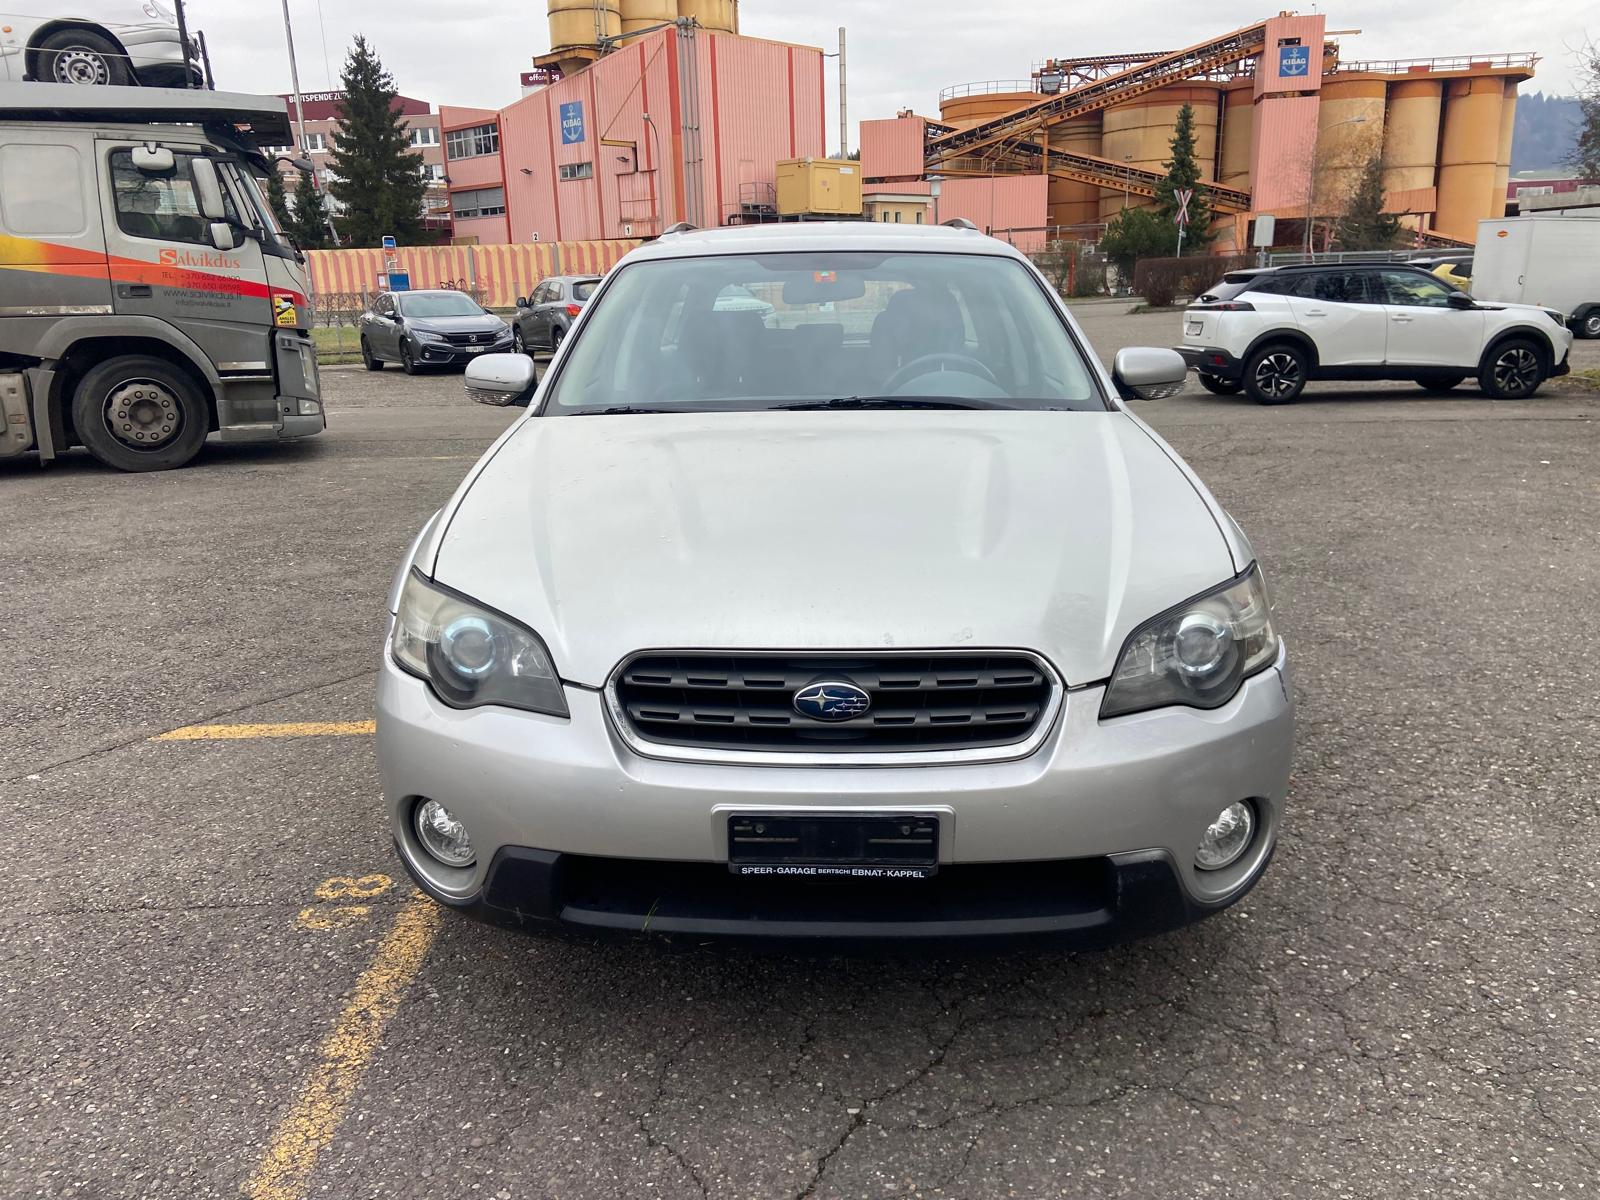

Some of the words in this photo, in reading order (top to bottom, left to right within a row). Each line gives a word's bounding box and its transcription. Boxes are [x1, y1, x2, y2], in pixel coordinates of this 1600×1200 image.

[288, 93, 334, 104] BLTSPENDE
[563, 118, 581, 128] KIBAG
[741, 867, 817, 875] SPEER-GARAGE
[851, 868, 925, 878] EBNAT-KAPPEL
